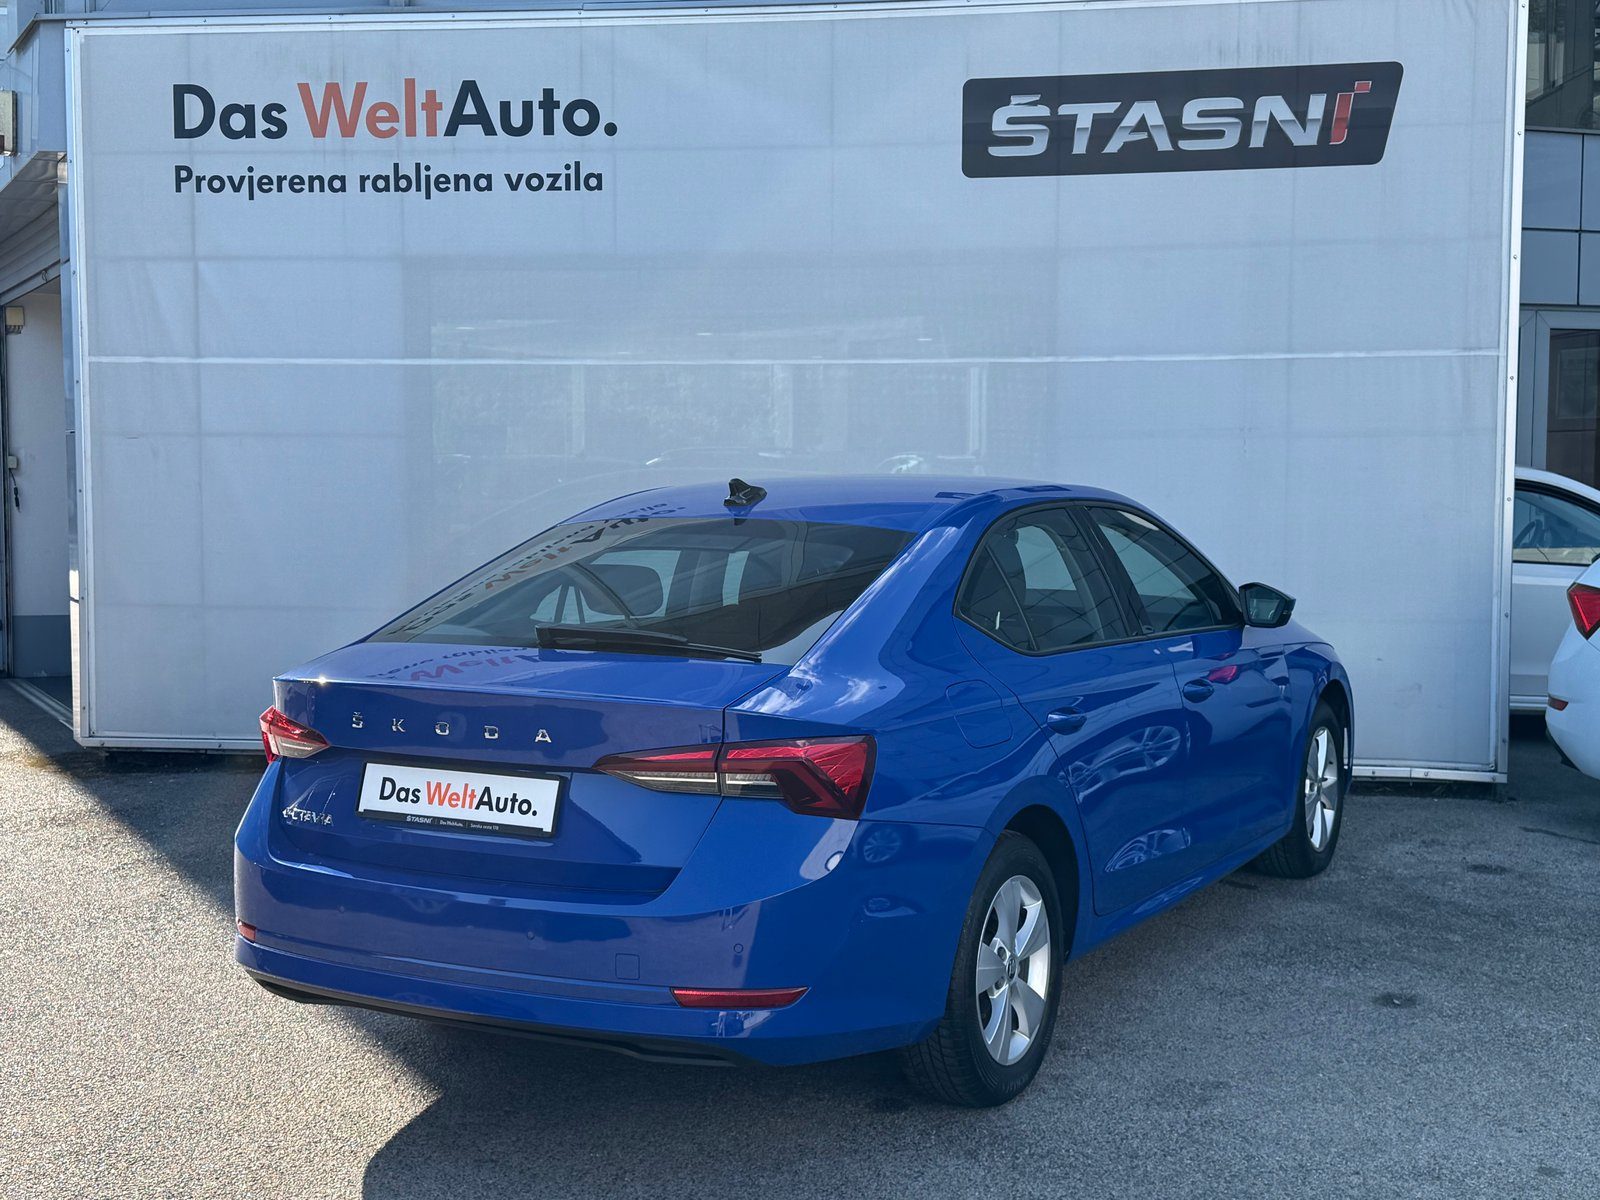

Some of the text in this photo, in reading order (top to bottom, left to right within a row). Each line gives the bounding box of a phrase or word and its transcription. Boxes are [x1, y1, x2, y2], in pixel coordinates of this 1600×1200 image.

[172, 77, 618, 140] Das WeltAuto.
[174, 160, 604, 201] Provjerena rabljena vozila
[352, 711, 552, 743] ŠKODA
[379, 776, 538, 818] Das WeltAuto.
